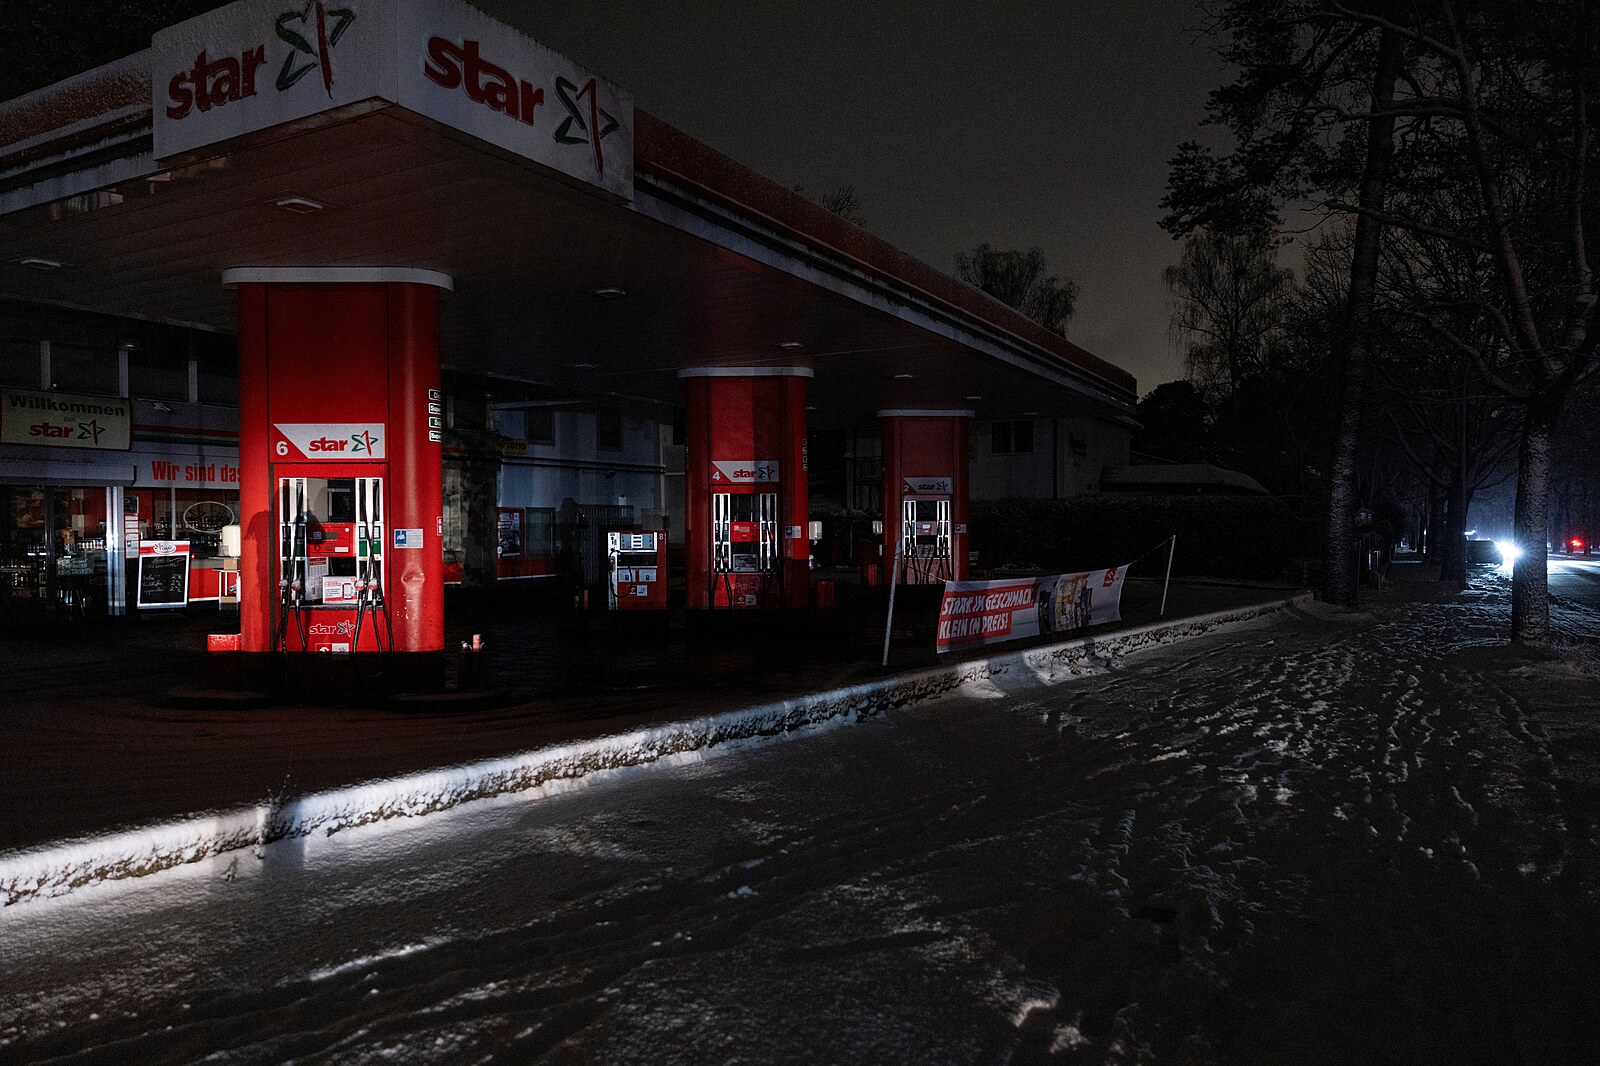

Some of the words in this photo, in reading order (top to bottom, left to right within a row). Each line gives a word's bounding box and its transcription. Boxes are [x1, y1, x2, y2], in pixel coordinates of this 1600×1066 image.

[167, 44, 268, 120] star
[424, 36, 544, 126] star
[8, 394, 125, 417] Willkommen
[28, 422, 74, 439] star
[275, 441, 289, 456] 6
[308, 436, 349, 452] star
[506, 441, 527, 450] LOTTO
[151, 460, 180, 481] Wir
[185, 462, 216, 482] sind
[712, 471, 721, 481] 4
[732, 469, 757, 479] star
[903, 484, 910, 492] 2
[917, 483, 936, 491] star
[658, 533, 664, 541] 8
[942, 596, 974, 616] STARK
[973, 595, 986, 611] IM
[309, 623, 337, 634] star
[939, 618, 968, 640] KLEIN
[968, 616, 981, 636] IM
[981, 612, 1009, 634] PREIS!
